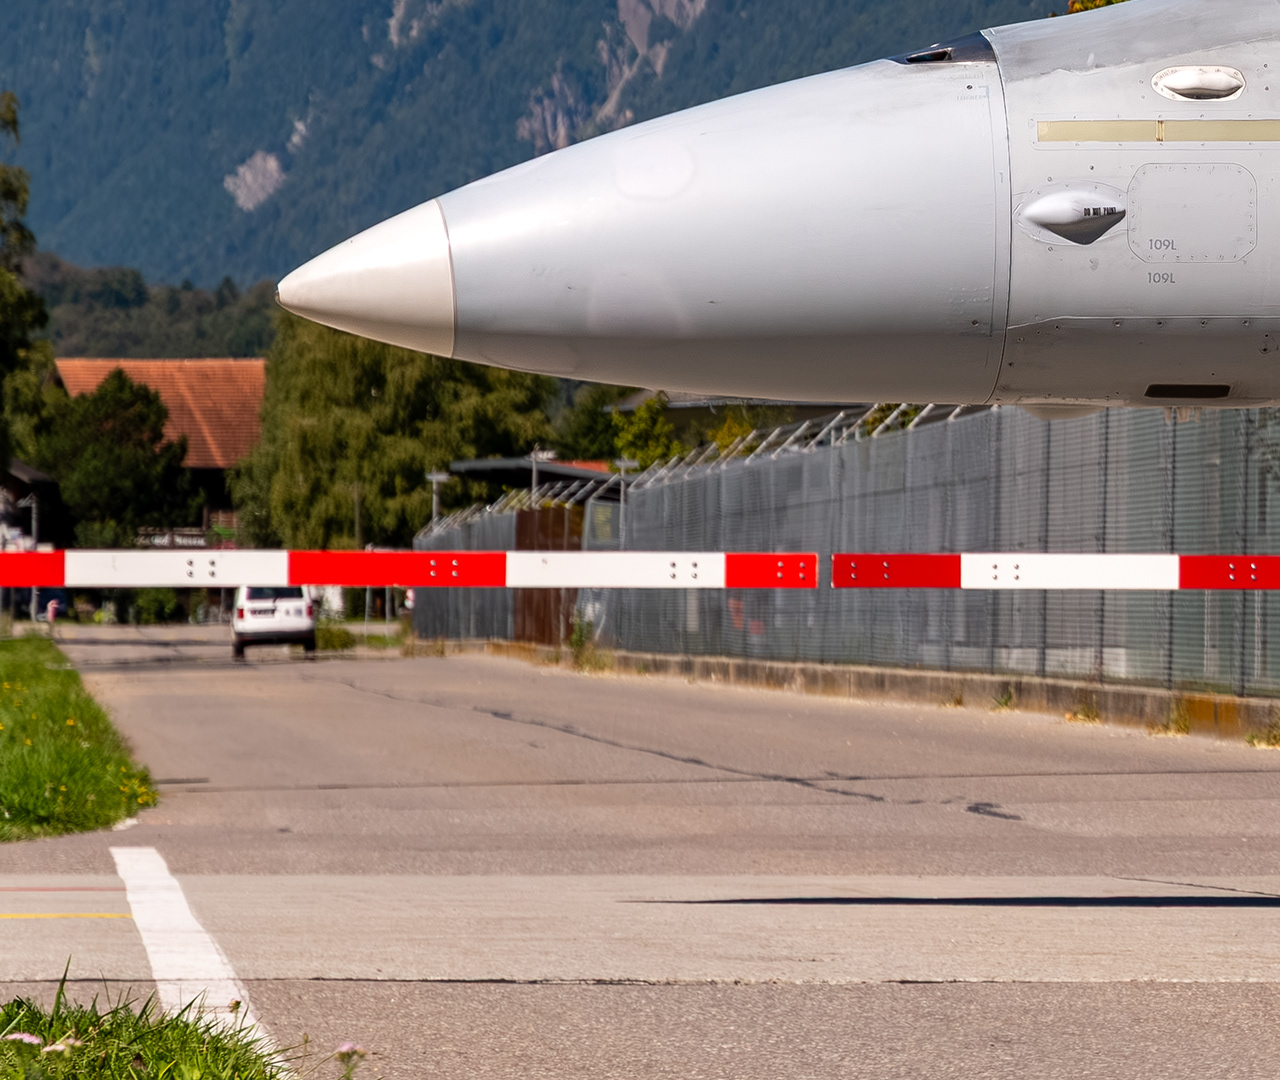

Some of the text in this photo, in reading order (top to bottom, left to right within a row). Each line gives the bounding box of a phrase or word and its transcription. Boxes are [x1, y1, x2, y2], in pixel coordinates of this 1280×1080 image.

[1083, 207, 1091, 217] DO
[1092, 207, 1101, 216] NOT
[1148, 238, 1177, 251] 109L
[1147, 272, 1176, 284] 109L
